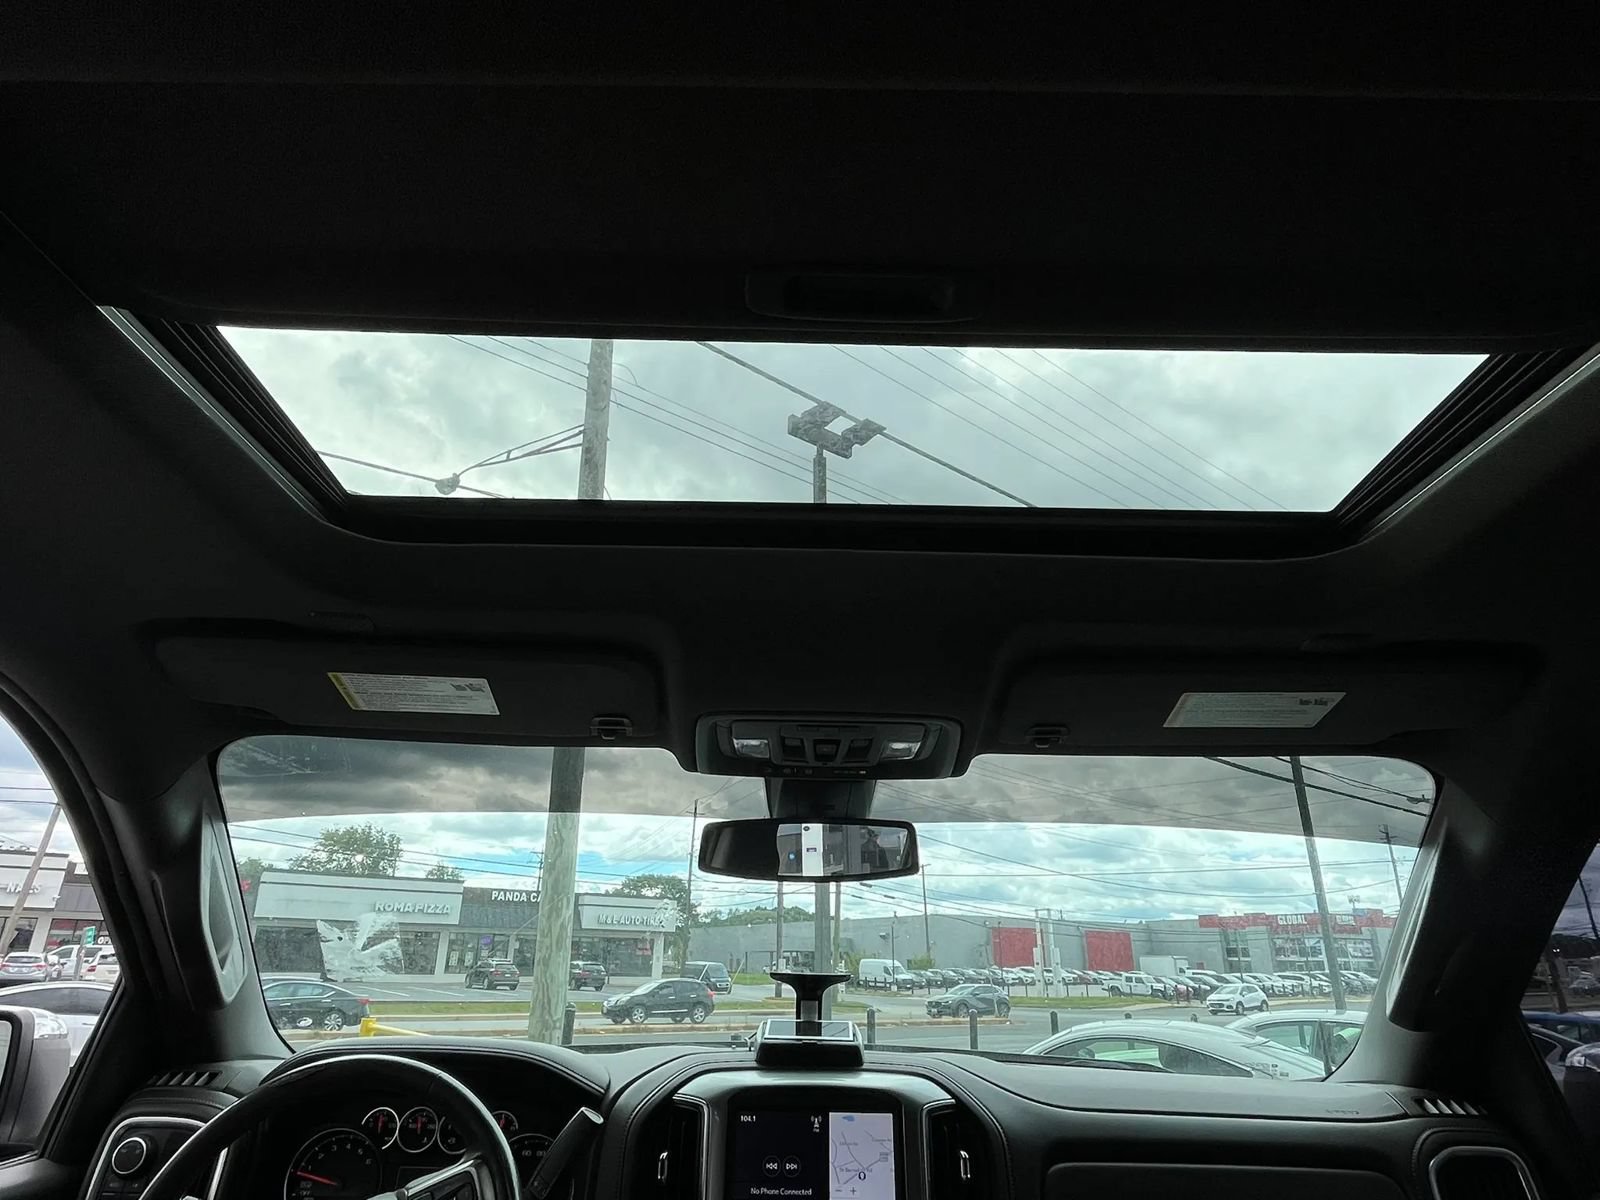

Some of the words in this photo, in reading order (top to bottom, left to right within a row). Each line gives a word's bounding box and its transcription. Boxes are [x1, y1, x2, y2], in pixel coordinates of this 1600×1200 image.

[6, 881, 41, 893] NAS
[491, 890, 528, 902] PANDA
[375, 902, 414, 914] ROMA
[414, 903, 450, 915] PIZZA
[619, 914, 641, 925] AUTO
[1277, 914, 1308, 926] GLOBAL
[740, 1114, 756, 1123] 104.1
[750, 1187, 760, 1195] No
[760, 1187, 780, 1195] Phone
[780, 1187, 812, 1196] Connected
